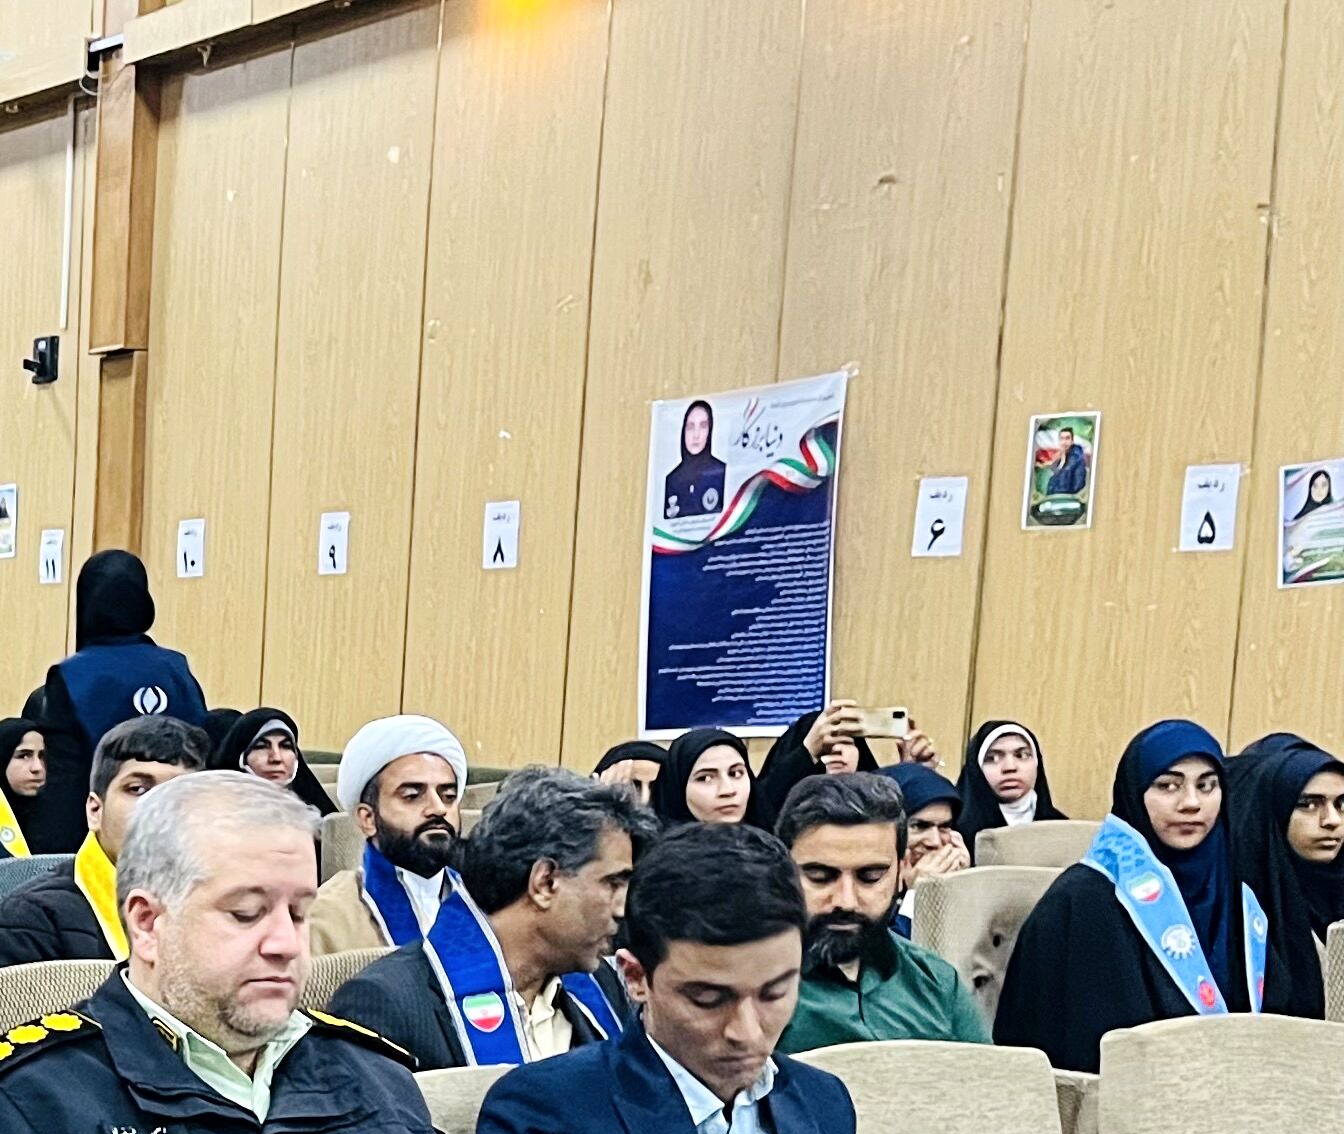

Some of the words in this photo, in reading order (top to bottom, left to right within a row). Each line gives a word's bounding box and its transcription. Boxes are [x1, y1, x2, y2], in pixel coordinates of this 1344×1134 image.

[927, 518, 946, 551] ۶
[1197, 510, 1216, 544] ۵
[183, 551, 196, 574] ۱۰
[328, 544, 337, 569] ۹
[492, 536, 505, 564] ۸
[45, 558, 56, 580] ۱۱
